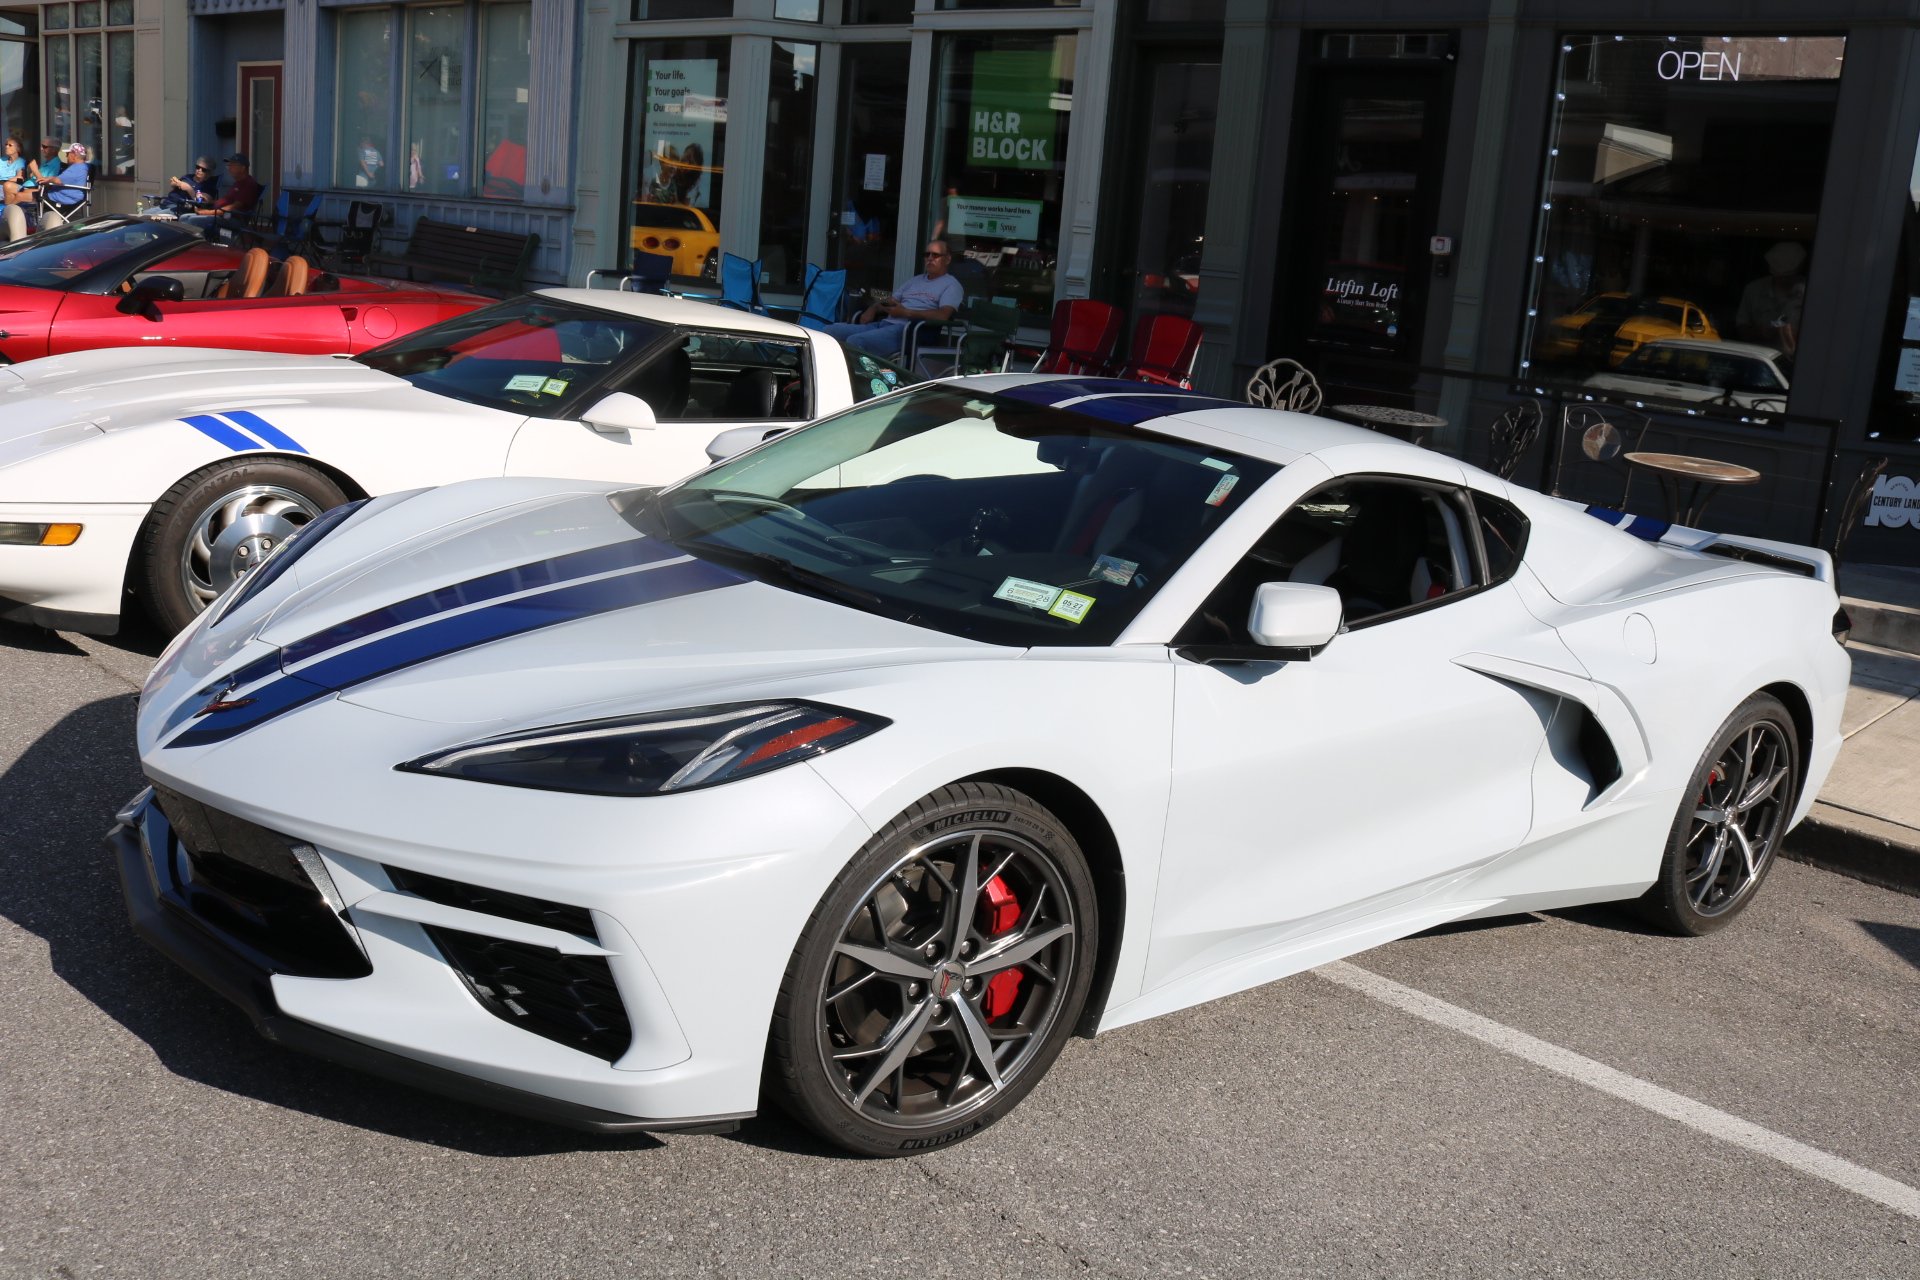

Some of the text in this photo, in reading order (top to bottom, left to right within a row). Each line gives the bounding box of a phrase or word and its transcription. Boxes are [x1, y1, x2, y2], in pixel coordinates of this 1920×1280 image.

[655, 69, 686, 80] Your life.
[1657, 51, 1741, 81] OPEN
[654, 87, 671, 96] Your
[974, 111, 1020, 134] H&R
[972, 136, 1047, 161] BLOCK
[1325, 277, 1399, 303] Litfin Loft
[1873, 496, 1902, 508] CENTURY
[933, 811, 1008, 831] MICHELIN
[902, 1123, 975, 1149] MICHELIN
